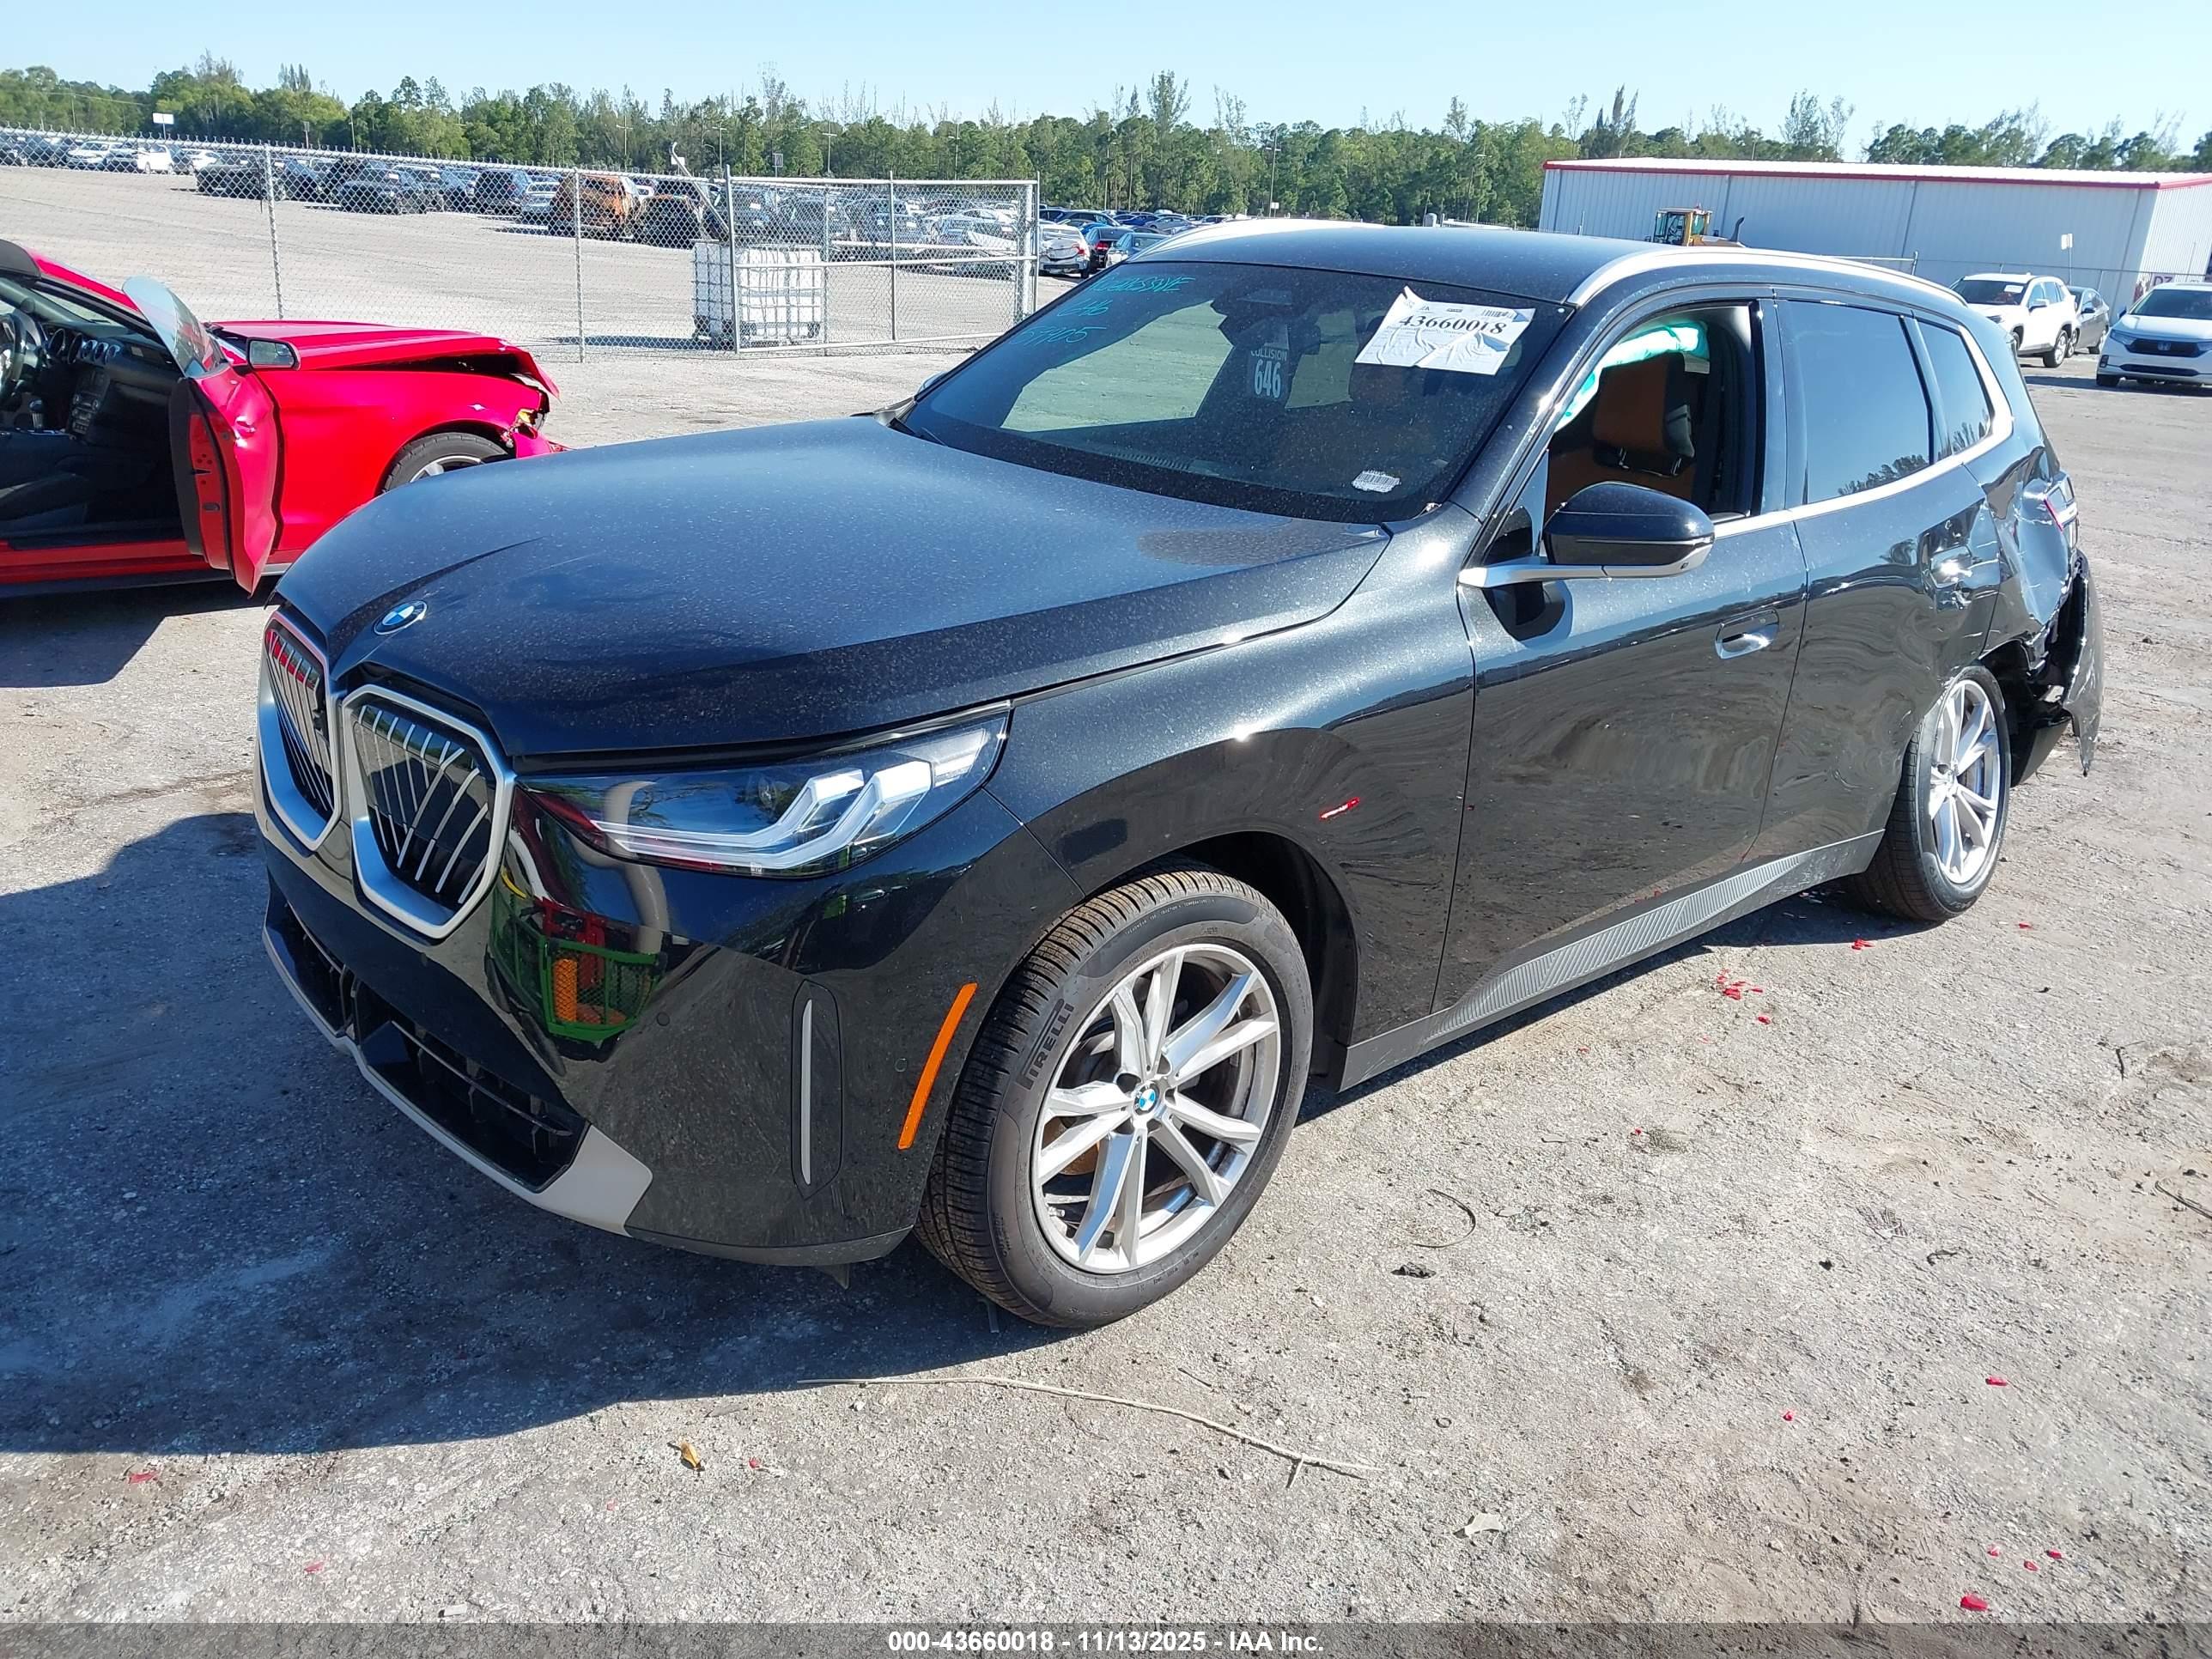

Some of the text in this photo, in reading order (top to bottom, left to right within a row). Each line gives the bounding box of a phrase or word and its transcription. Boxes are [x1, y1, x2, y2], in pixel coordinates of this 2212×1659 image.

[1398, 314, 1507, 335] 43660018
[1255, 358, 1281, 398] 646
[1016, 999, 1075, 1091] PIRELLI
